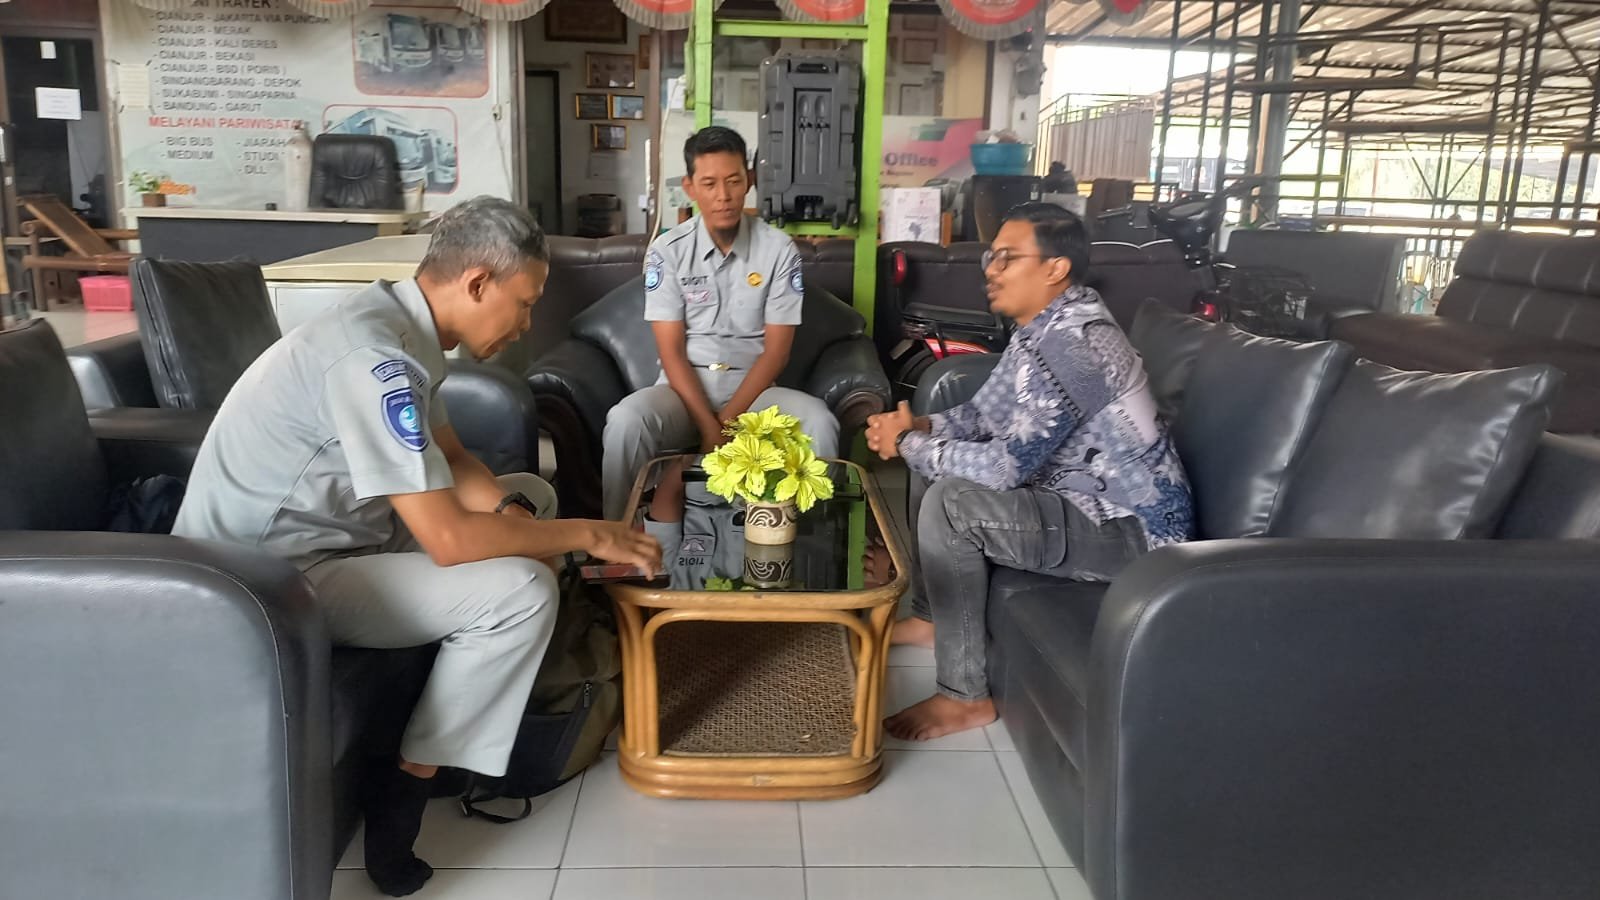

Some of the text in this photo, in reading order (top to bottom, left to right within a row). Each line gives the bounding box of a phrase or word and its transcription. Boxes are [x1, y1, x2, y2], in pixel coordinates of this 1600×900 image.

[155, 11, 204, 22] CIANJUR
[213, 13, 263, 23] JAKARTA
[265, 14, 283, 24] VIA
[157, 24, 252, 35] CIANJUR MERAK
[158, 37, 278, 49] CIANJUR KALI DERES
[159, 50, 256, 61] CIANJUR BEKASI
[160, 63, 208, 73] CIANJUR
[216, 64, 239, 74] BSD
[161, 76, 301, 88] SINDANGBARANG DEPOK
[162, 88, 297, 100] SUKABUMI SINGAPARNA
[163, 101, 262, 112] BANDUNG GARUT
[149, 116, 215, 128] MELAYANI
[166, 136, 214, 146] BIG BUS
[168, 150, 214, 160] MEDIUM
[245, 151, 279, 161] STUDI
[885, 152, 937, 167] Office
[245, 165, 266, 175] DLL
[681, 275, 708, 287] SIGIT
